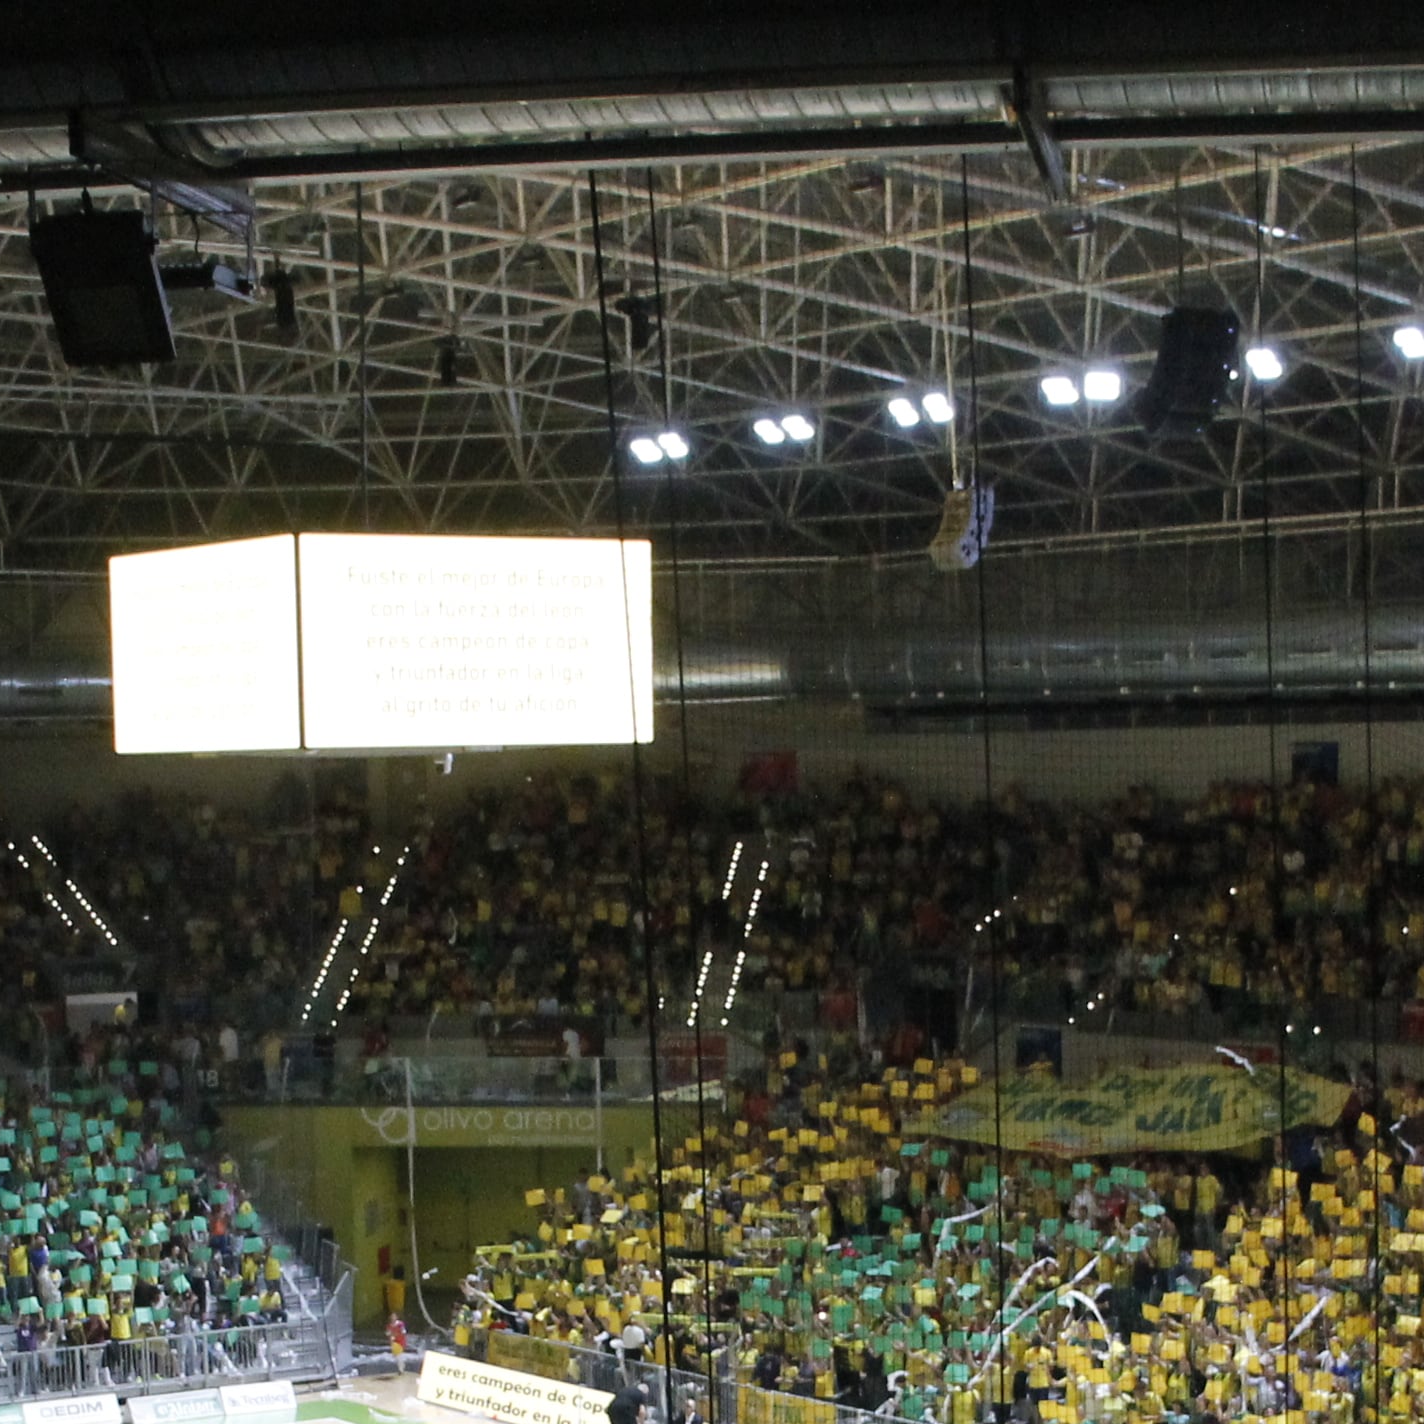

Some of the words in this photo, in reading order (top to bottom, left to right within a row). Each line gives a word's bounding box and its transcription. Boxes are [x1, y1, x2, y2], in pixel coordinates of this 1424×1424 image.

[347, 565, 409, 585] Fuiste
[417, 568, 433, 585] el
[442, 569, 497, 590] mejor
[507, 569, 528, 586] de
[537, 568, 604, 589] Europa
[371, 602, 405, 617] con
[415, 600, 430, 617] la
[439, 600, 500, 618] fuerza
[508, 600, 535, 617] del
[366, 635, 410, 650] eres
[516, 632, 537, 649] de
[545, 634, 589, 652] copa
[390, 664, 487, 681] triunfador
[497, 667, 519, 681] en
[528, 664, 542, 681] la
[382, 697, 397, 712] al
[406, 696, 451, 718] grito
[459, 696, 481, 713] de
[423, 1107, 494, 1131] olivo
[503, 1108, 597, 1132] arena
[438, 1365, 467, 1380] eres
[472, 1372, 541, 1398] campeón
[547, 1388, 567, 1404] de
[572, 1394, 607, 1415] Cop
[435, 1386, 445, 1399] y
[448, 1388, 527, 1418] triunfador
[533, 1411, 551, 1424] en
